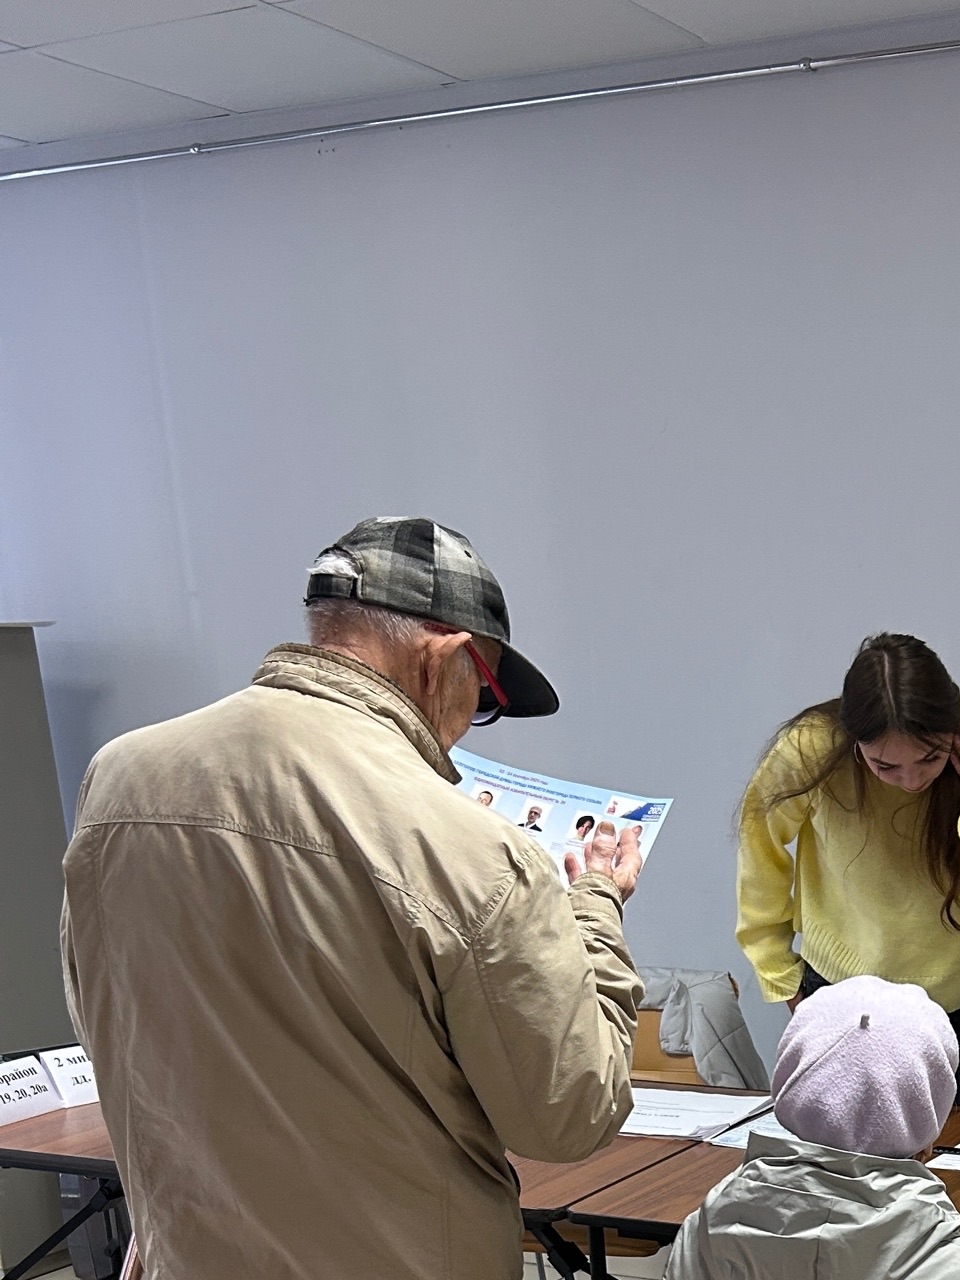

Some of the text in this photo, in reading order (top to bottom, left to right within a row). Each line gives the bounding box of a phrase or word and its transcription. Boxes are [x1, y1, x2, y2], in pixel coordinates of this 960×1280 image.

[54, 1057, 64, 1068] 2
[14, 1088, 32, 1101] 20,
[29, 1083, 49, 1096] 20а
